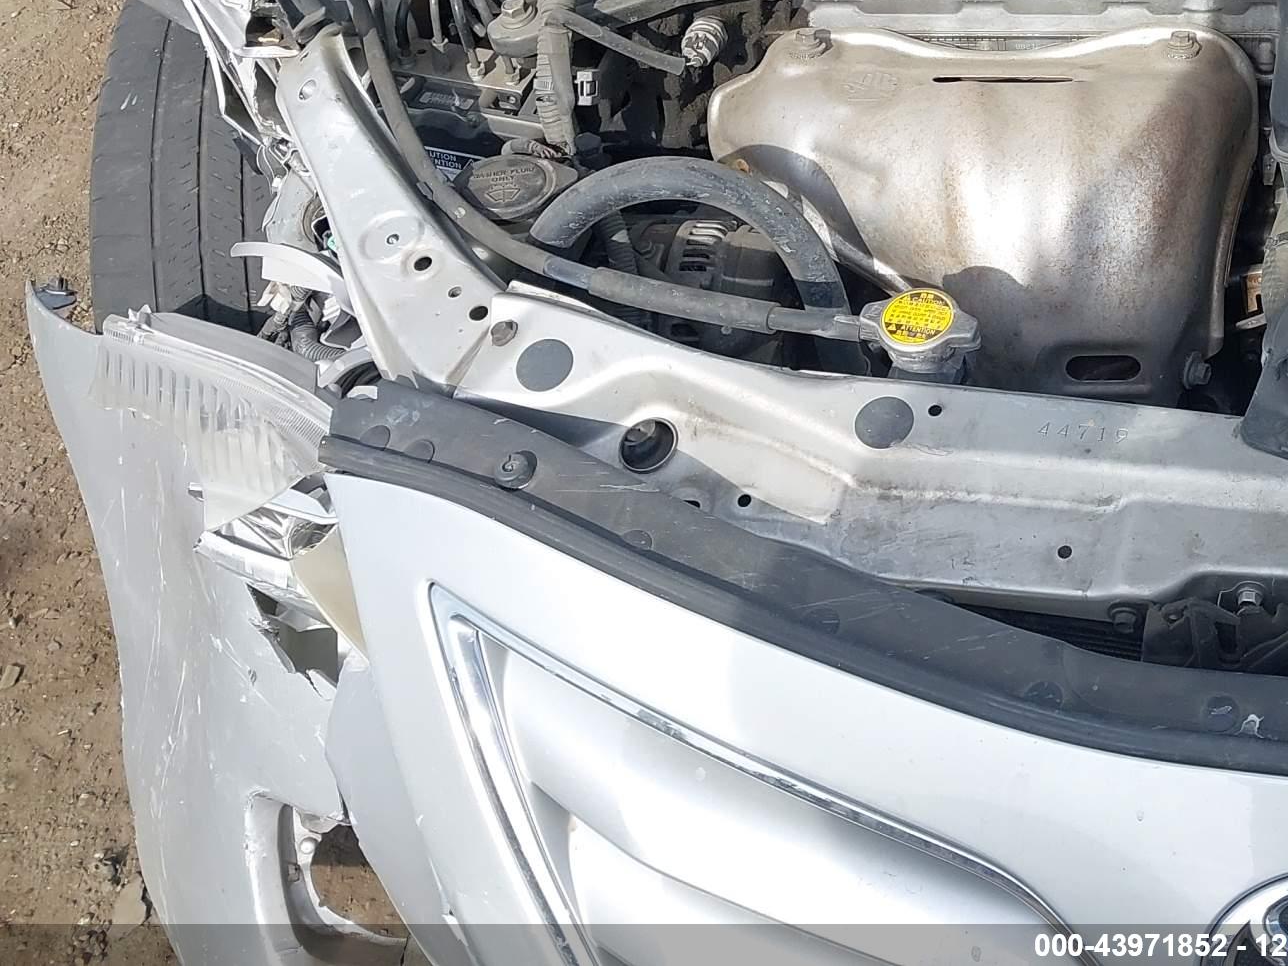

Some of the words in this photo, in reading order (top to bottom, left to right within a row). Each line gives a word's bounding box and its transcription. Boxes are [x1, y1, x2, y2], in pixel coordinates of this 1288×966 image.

[429, 150, 457, 162] UTION
[434, 159, 462, 170] NTION
[510, 165, 536, 175] FLUID
[490, 175, 516, 183] ONLY
